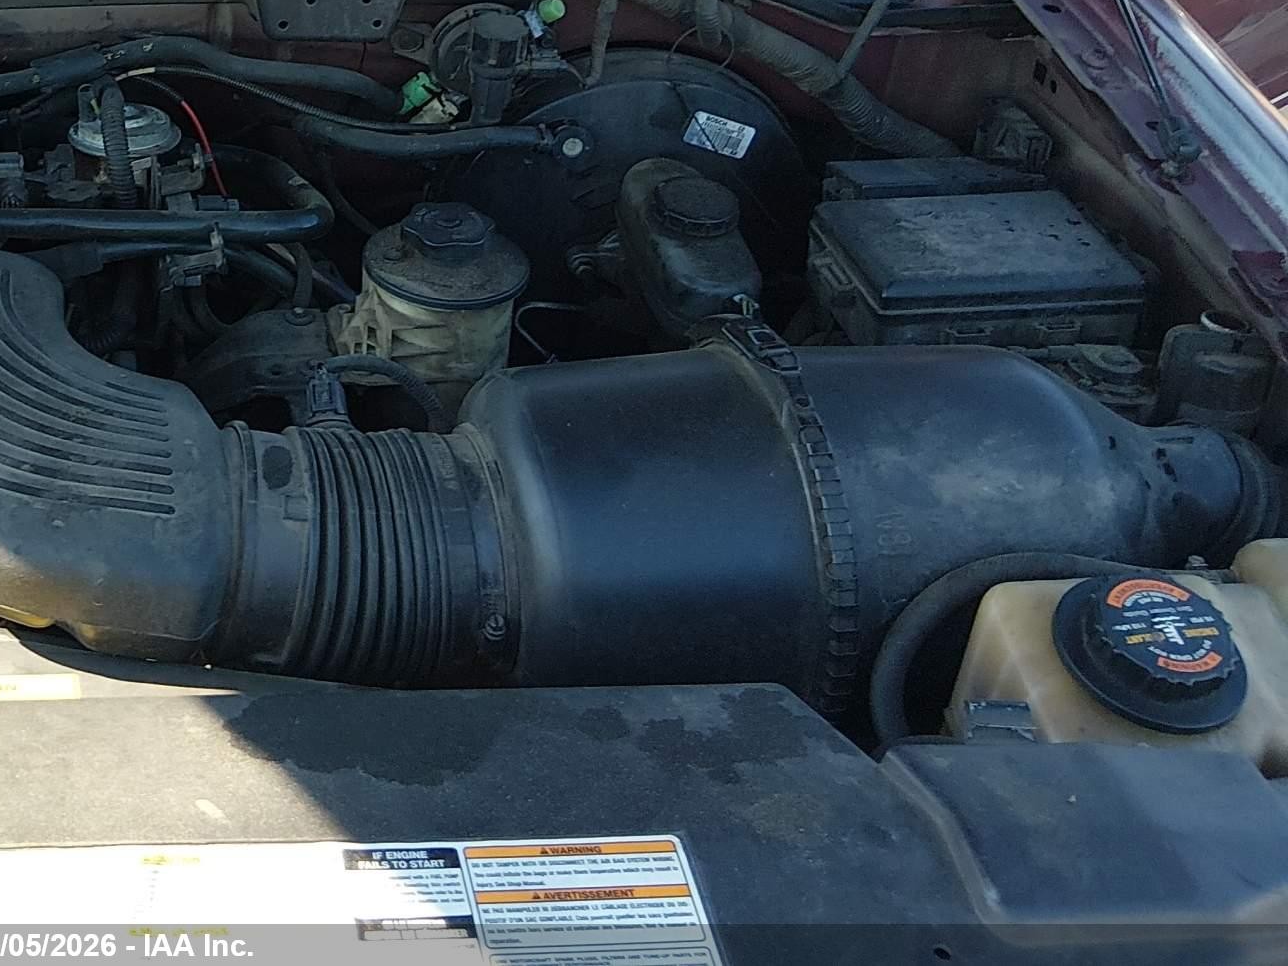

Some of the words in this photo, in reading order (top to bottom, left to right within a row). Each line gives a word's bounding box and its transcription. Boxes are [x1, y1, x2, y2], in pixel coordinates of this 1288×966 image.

[705, 115, 728, 127] BOSCH
[372, 851, 383, 860] IF
[385, 850, 429, 860] ENGINE
[550, 846, 602, 854] WARNING
[357, 860, 390, 869] FAILS
[393, 860, 408, 869] TO
[410, 859, 446, 869] START
[543, 889, 635, 900] AVERTISSEMENT
